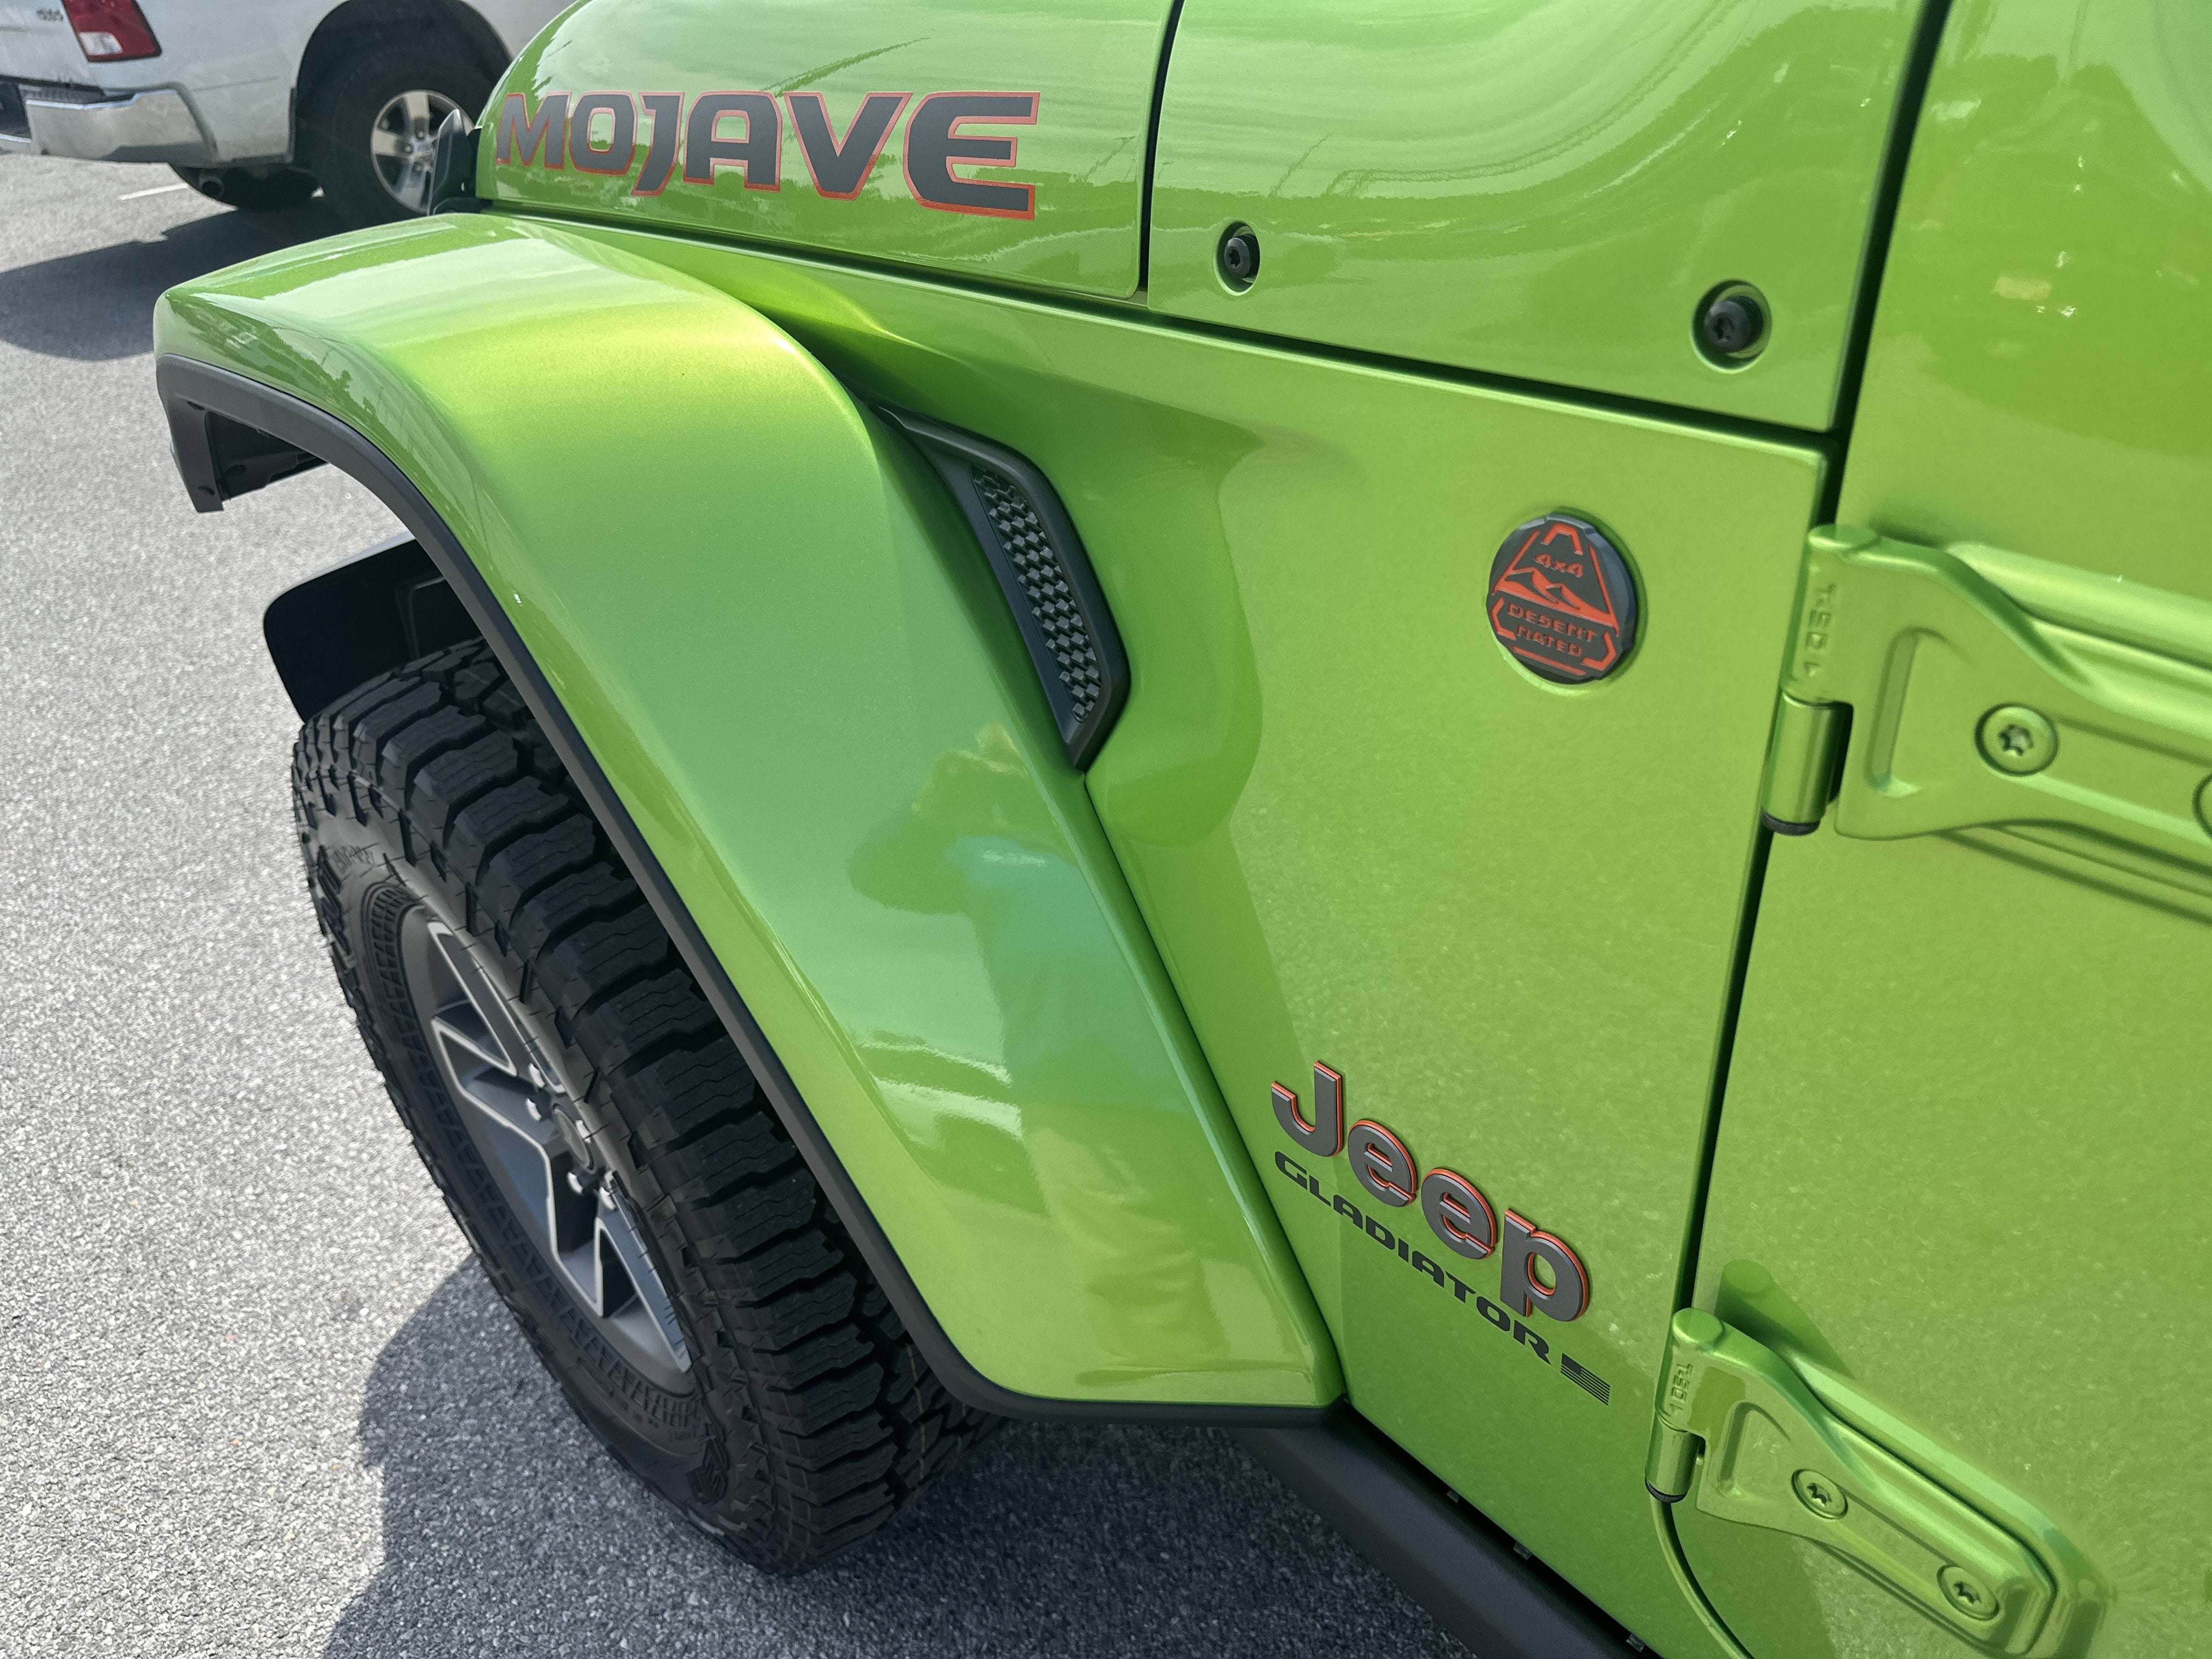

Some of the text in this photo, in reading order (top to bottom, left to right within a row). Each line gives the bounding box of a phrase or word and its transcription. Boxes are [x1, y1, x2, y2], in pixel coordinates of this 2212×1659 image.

[495, 90, 1041, 220] MOJAVE
[1534, 553, 1583, 578] 4x4
[1508, 602, 1598, 643] DESERT
[1516, 624, 1583, 657] RATED
[1271, 1059, 1590, 1322] Jeep
[1274, 1150, 1551, 1365] GLADIATOR
